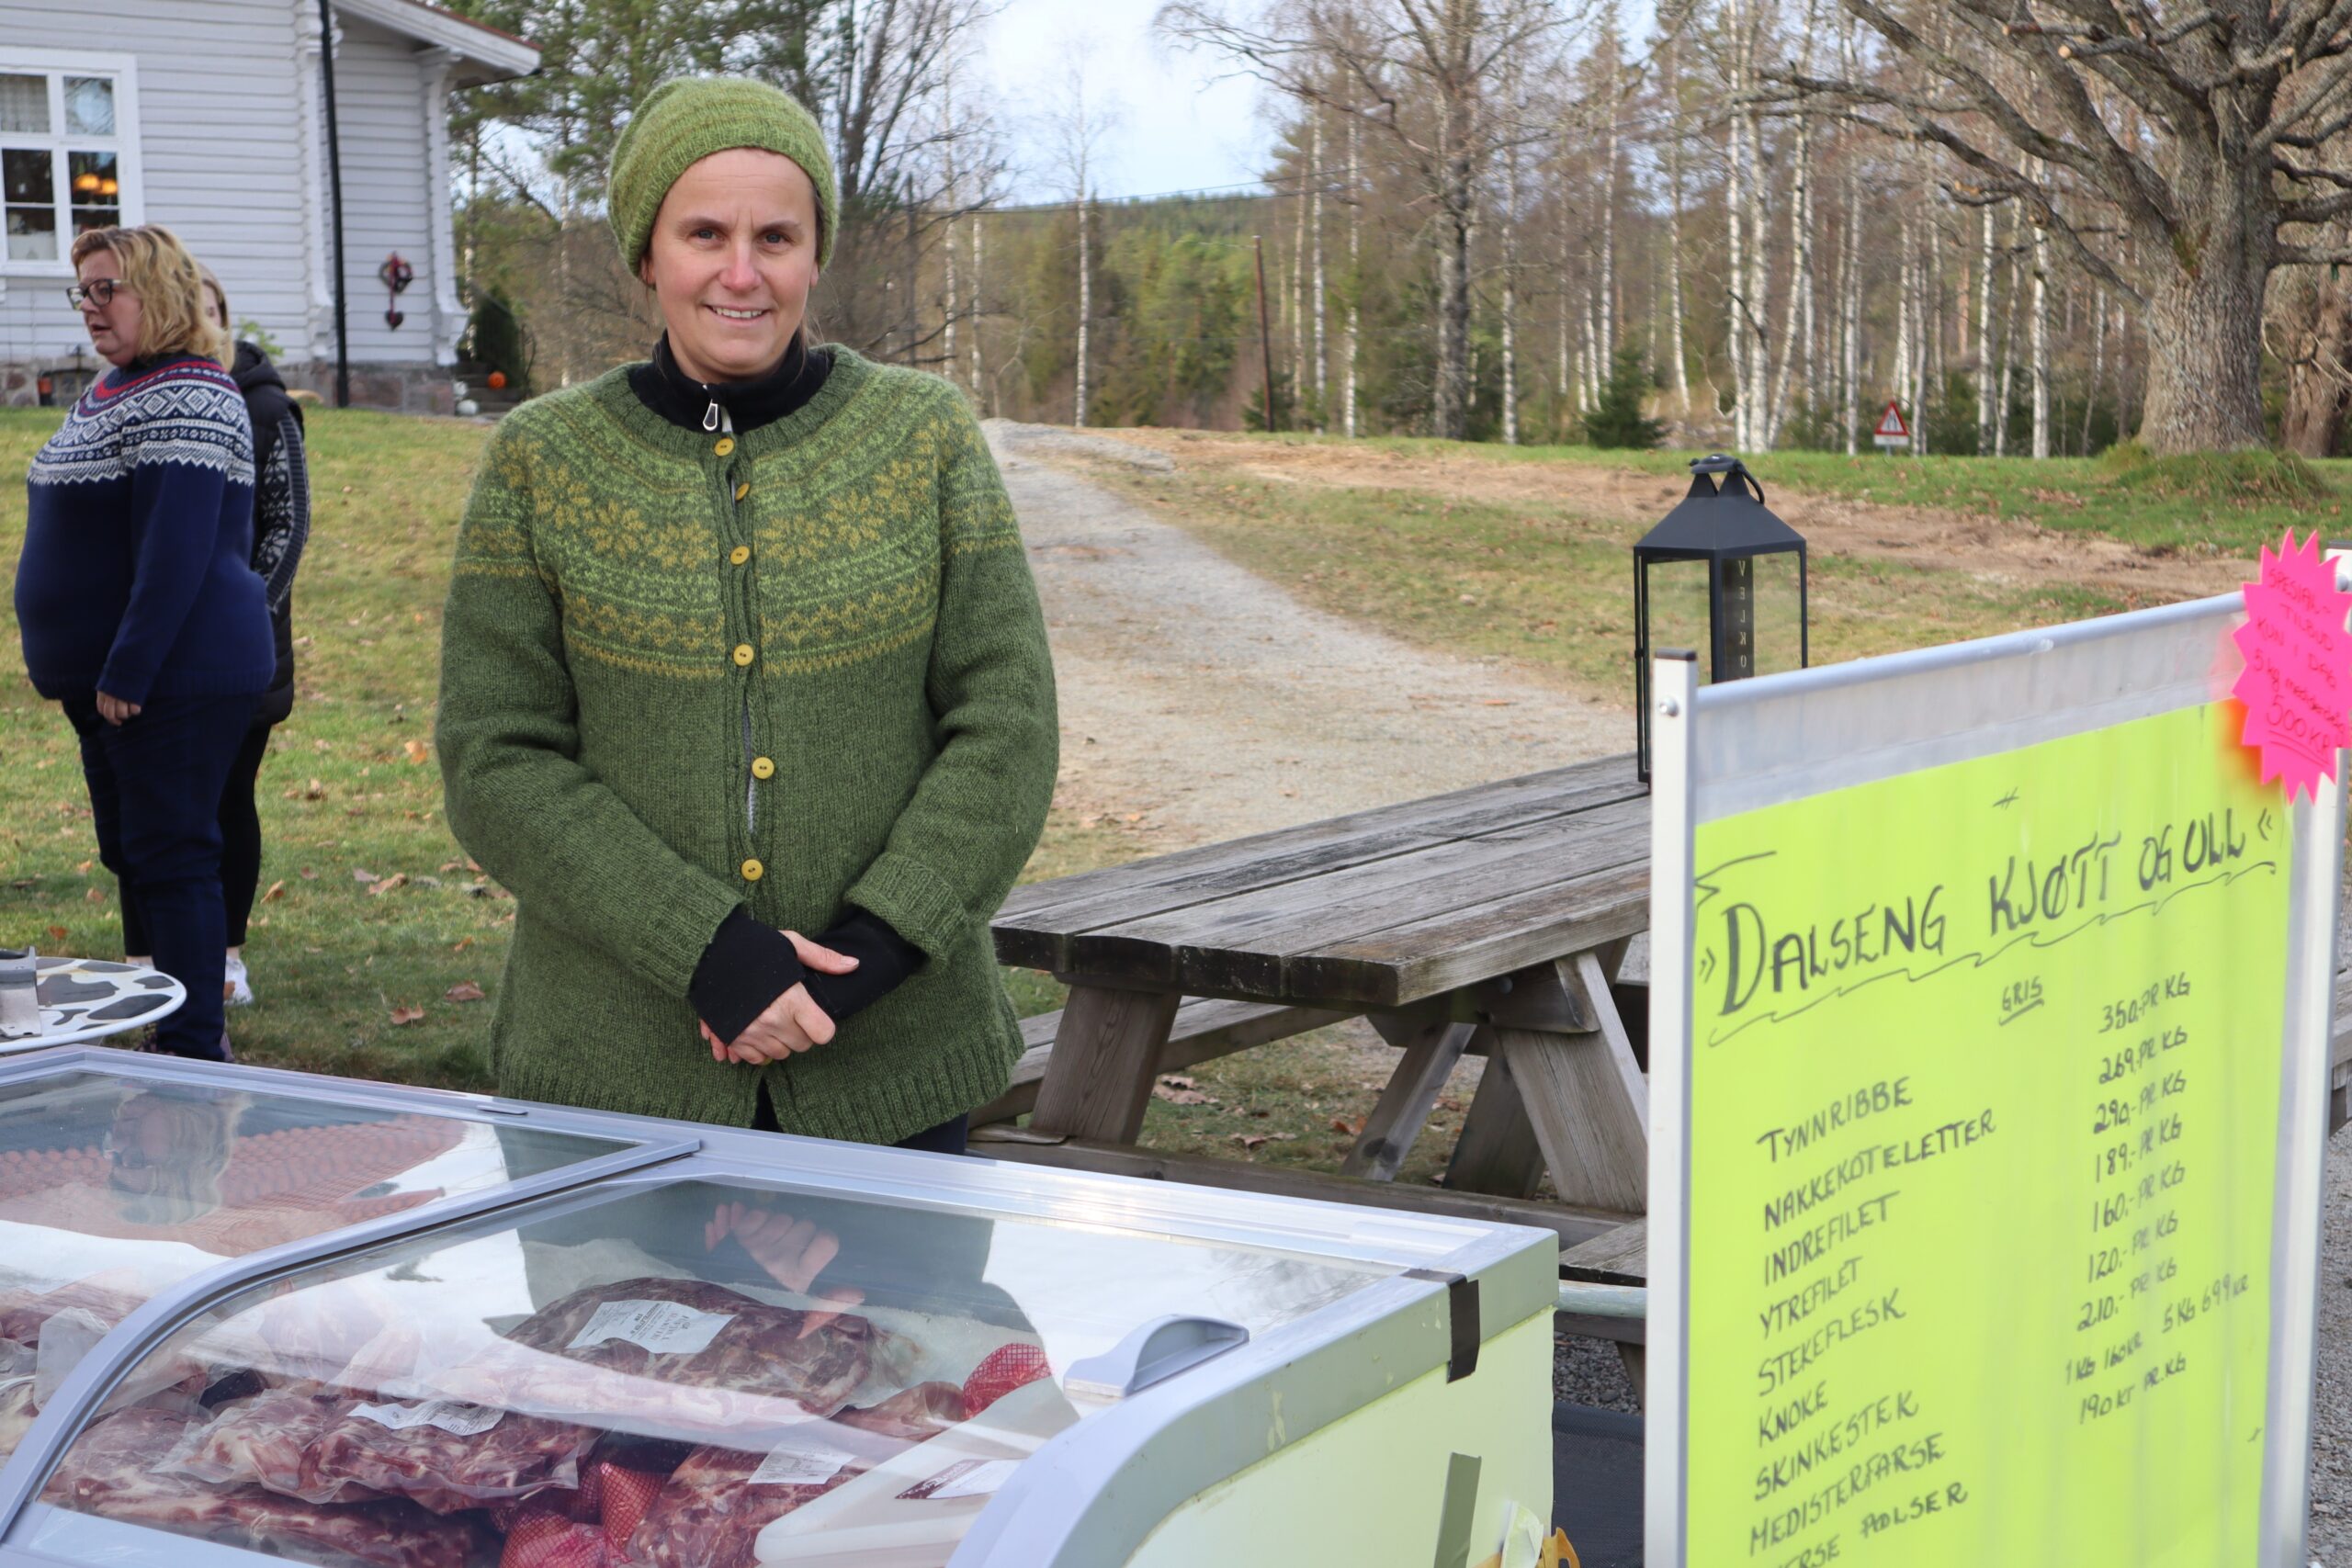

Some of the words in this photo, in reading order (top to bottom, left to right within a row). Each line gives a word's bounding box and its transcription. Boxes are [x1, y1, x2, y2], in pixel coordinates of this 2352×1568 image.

[2256, 617, 2284, 647] KUN
[2266, 694, 2307, 738] 500
[1988, 829, 2121, 936] KJØTT
[2138, 824, 2174, 891] OG
[2002, 976, 2043, 1012] GRIS
[2165, 971, 2190, 999] KG
[2161, 1025, 2188, 1051] KG
[2161, 1069, 2187, 1098] KG
[1756, 1076, 1913, 1163] TYNNRIBBE
[2159, 1112, 2182, 1145] KG
[1764, 1108, 1996, 1232] NAKKEKOTELETTER
[2159, 1159, 2186, 1191] KG
[1763, 1190, 1901, 1287] INDREFILET
[2155, 1210, 2178, 1240] KG
[2156, 1257, 2177, 1284] KG
[1759, 1256, 1863, 1340] YTREFILET
[2161, 1303, 2174, 1334] 5
[1758, 1288, 1906, 1396] STEKEFLESK
[1758, 1380, 1828, 1449] KNOKE
[1755, 1390, 1918, 1502] SKINKESTEK
[1749, 1432, 1946, 1557] MEDISTERFARSE
